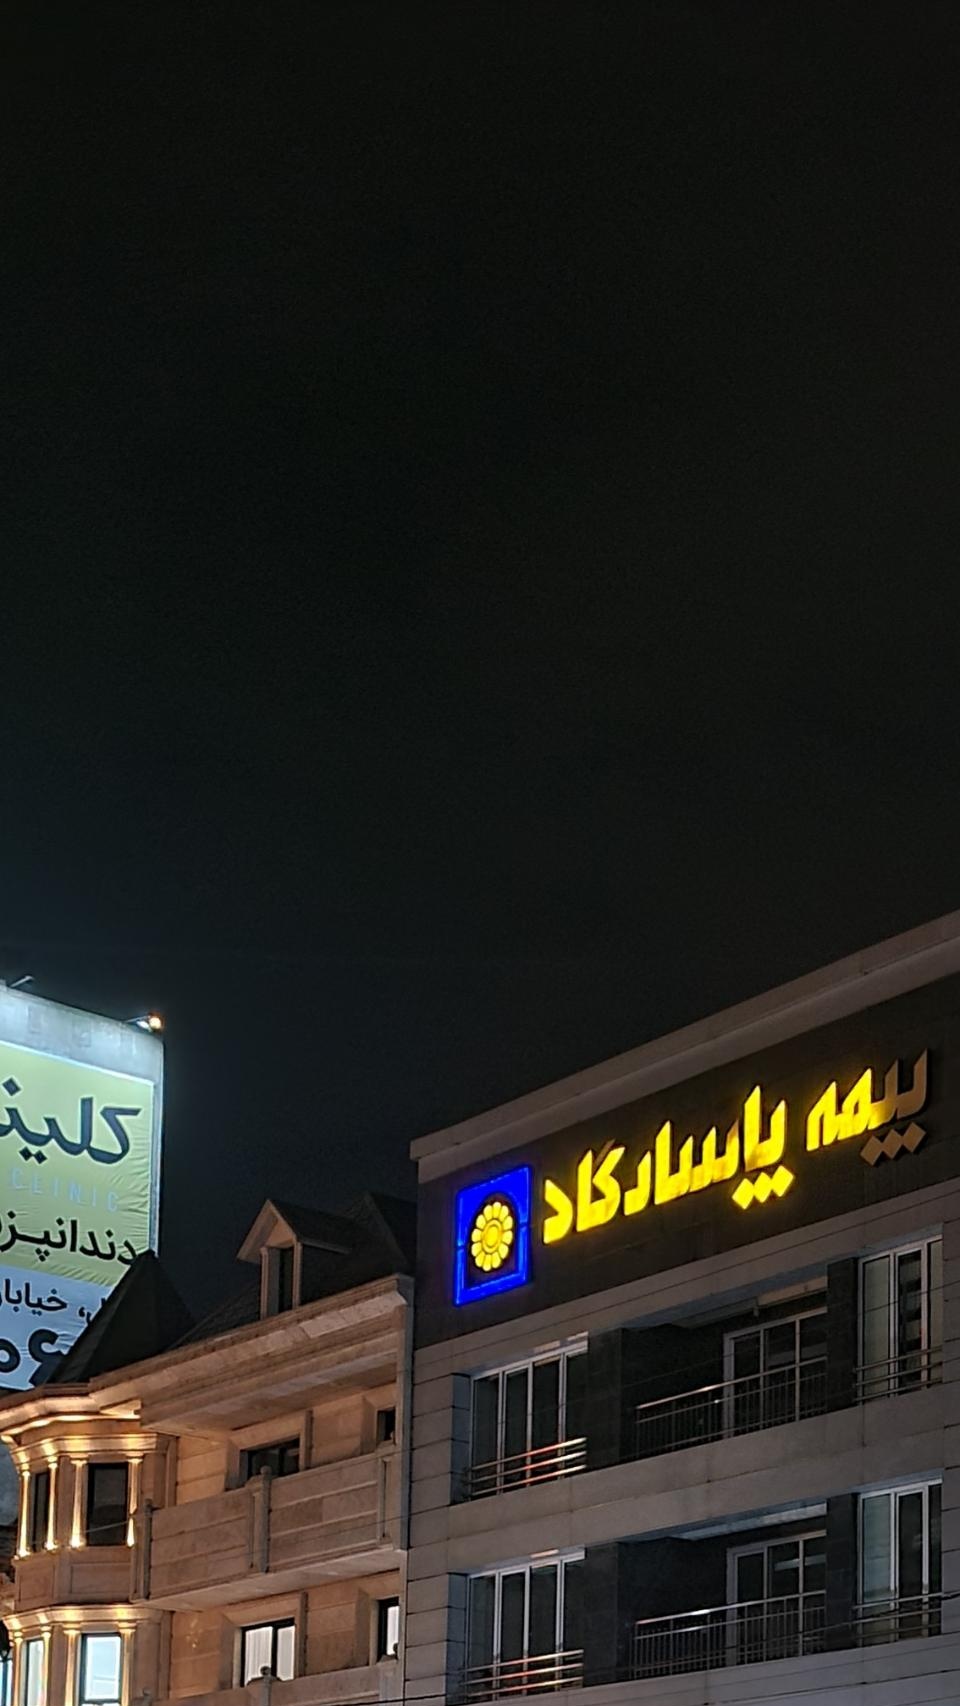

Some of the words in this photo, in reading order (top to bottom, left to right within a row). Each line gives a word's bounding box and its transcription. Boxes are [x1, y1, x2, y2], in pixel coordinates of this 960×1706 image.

[0, 1077, 140, 1164] کلین
[805, 1048, 928, 1166] بیمه
[543, 1085, 795, 1244] پاسارگاد
[0, 1210, 138, 1265] دندانپز
[0, 1278, 68, 1316] خیابا
